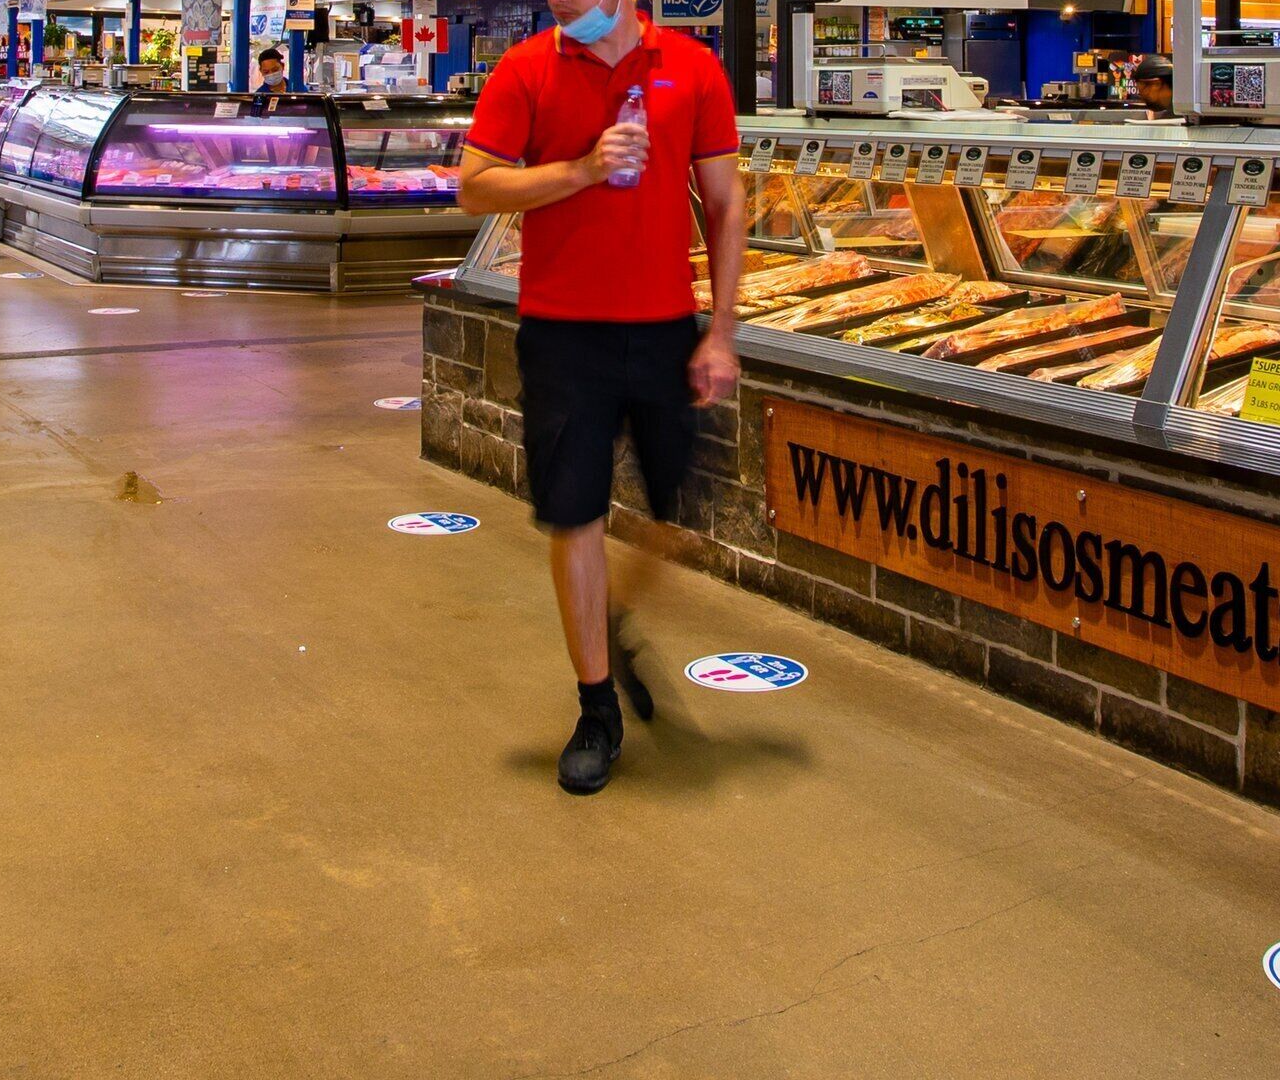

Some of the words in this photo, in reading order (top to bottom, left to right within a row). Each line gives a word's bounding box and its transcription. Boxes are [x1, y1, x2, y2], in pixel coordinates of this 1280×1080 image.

[1249, 379, 1266, 388] LEAN
[1250, 397, 1256, 406] 3
[1257, 400, 1268, 409] LBS
